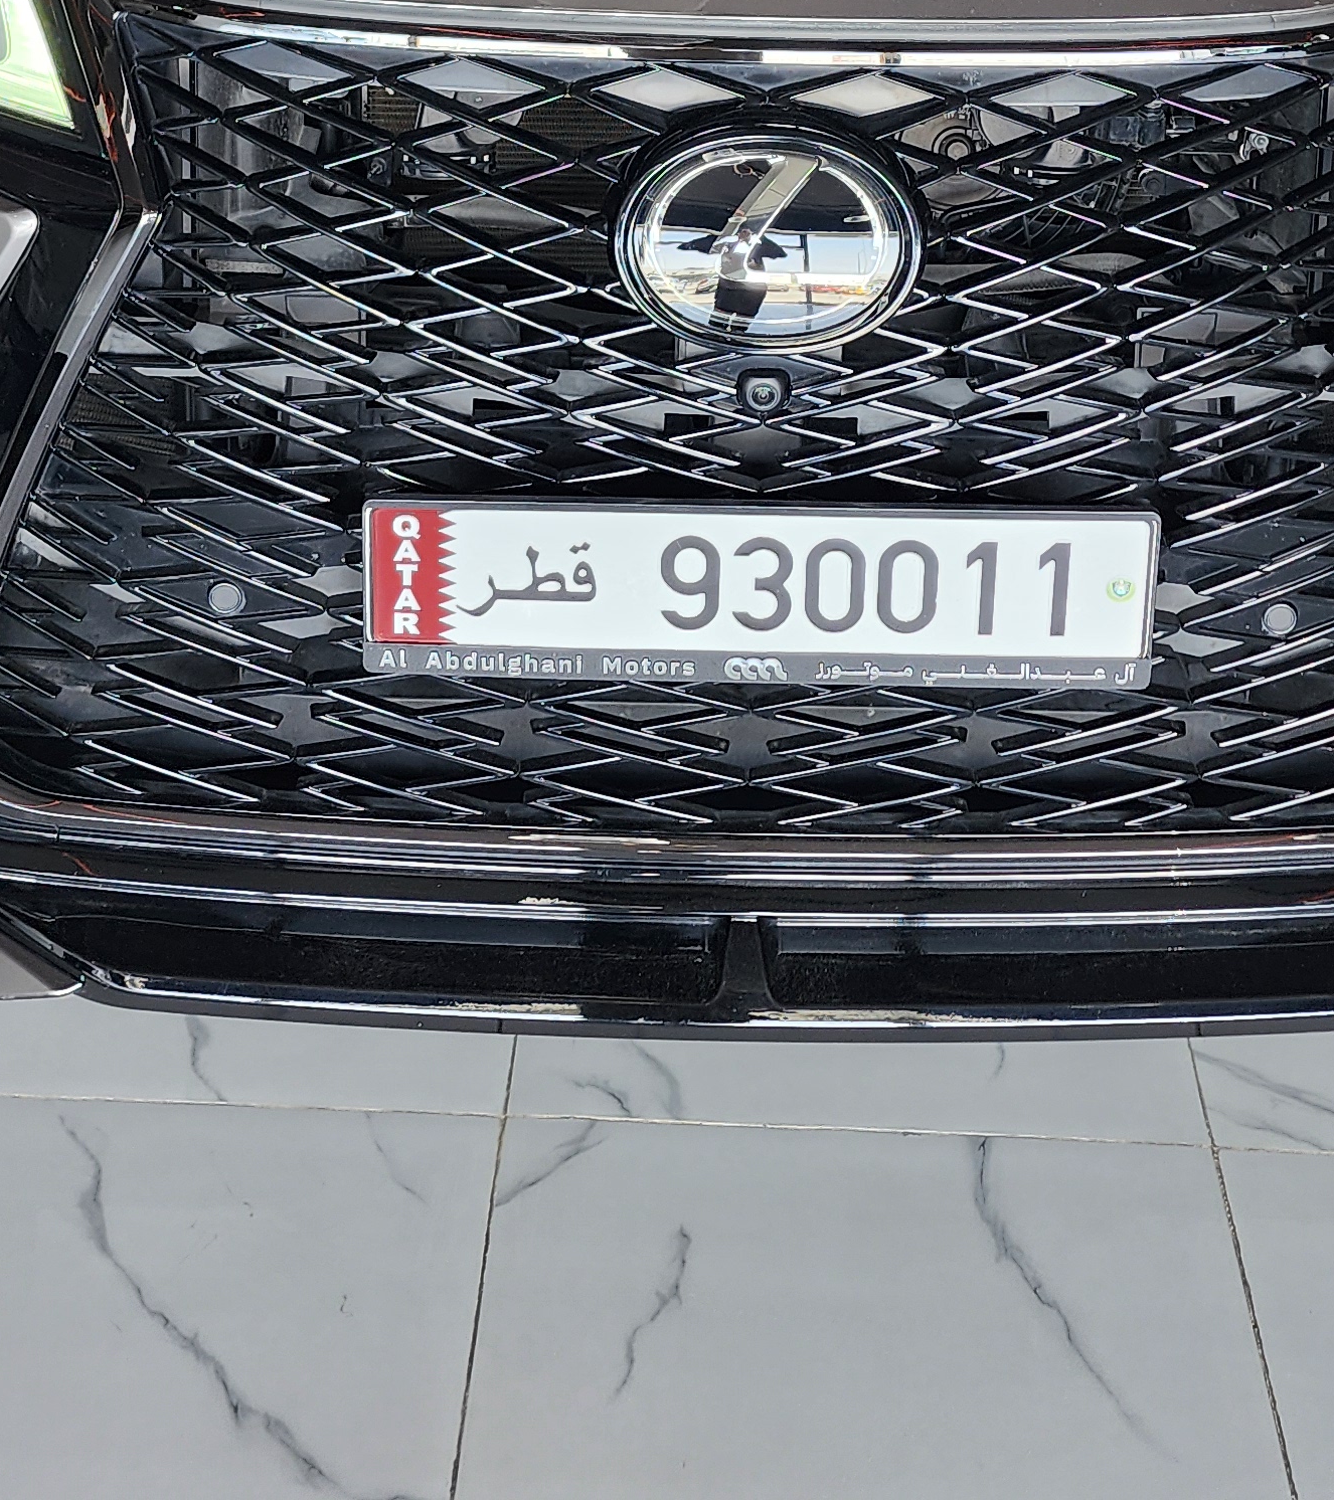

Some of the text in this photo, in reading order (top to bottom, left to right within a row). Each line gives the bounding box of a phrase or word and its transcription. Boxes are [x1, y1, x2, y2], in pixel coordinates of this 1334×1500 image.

[391, 513, 422, 636] QATAR
[455, 541, 597, 617] قطر
[660, 535, 1072, 637] 930011
[378, 649, 408, 669] Al
[424, 650, 584, 676] Abdulghani
[602, 655, 697, 678] Motors
